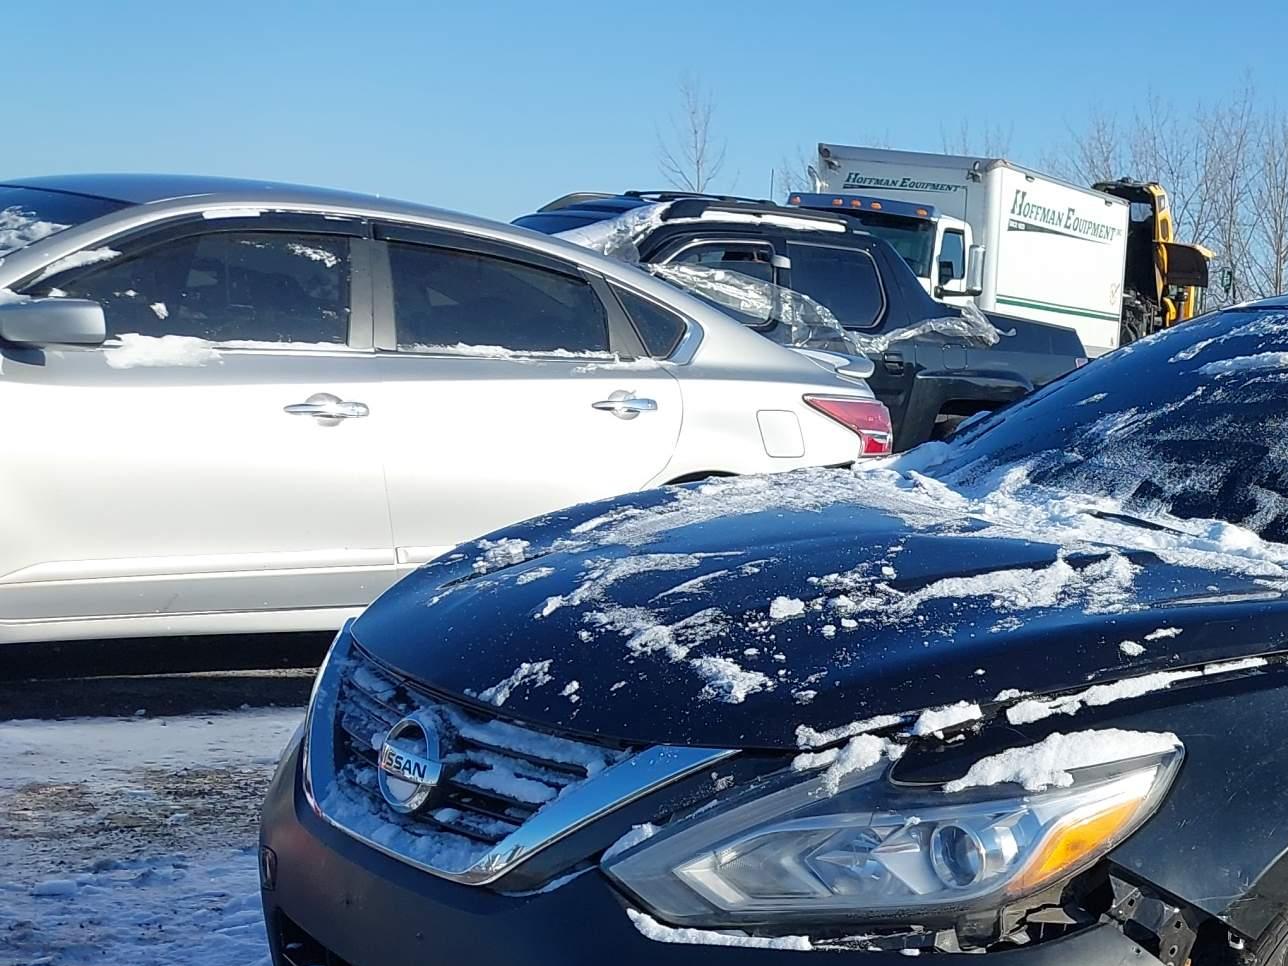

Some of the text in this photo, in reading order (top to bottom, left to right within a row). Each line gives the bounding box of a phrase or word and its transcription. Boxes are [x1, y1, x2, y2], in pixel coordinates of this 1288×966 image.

[845, 172, 960, 192] HOFFMAN EQUIPMENT
[1010, 189, 1116, 241] HOFFMAN EQUIPMENT
